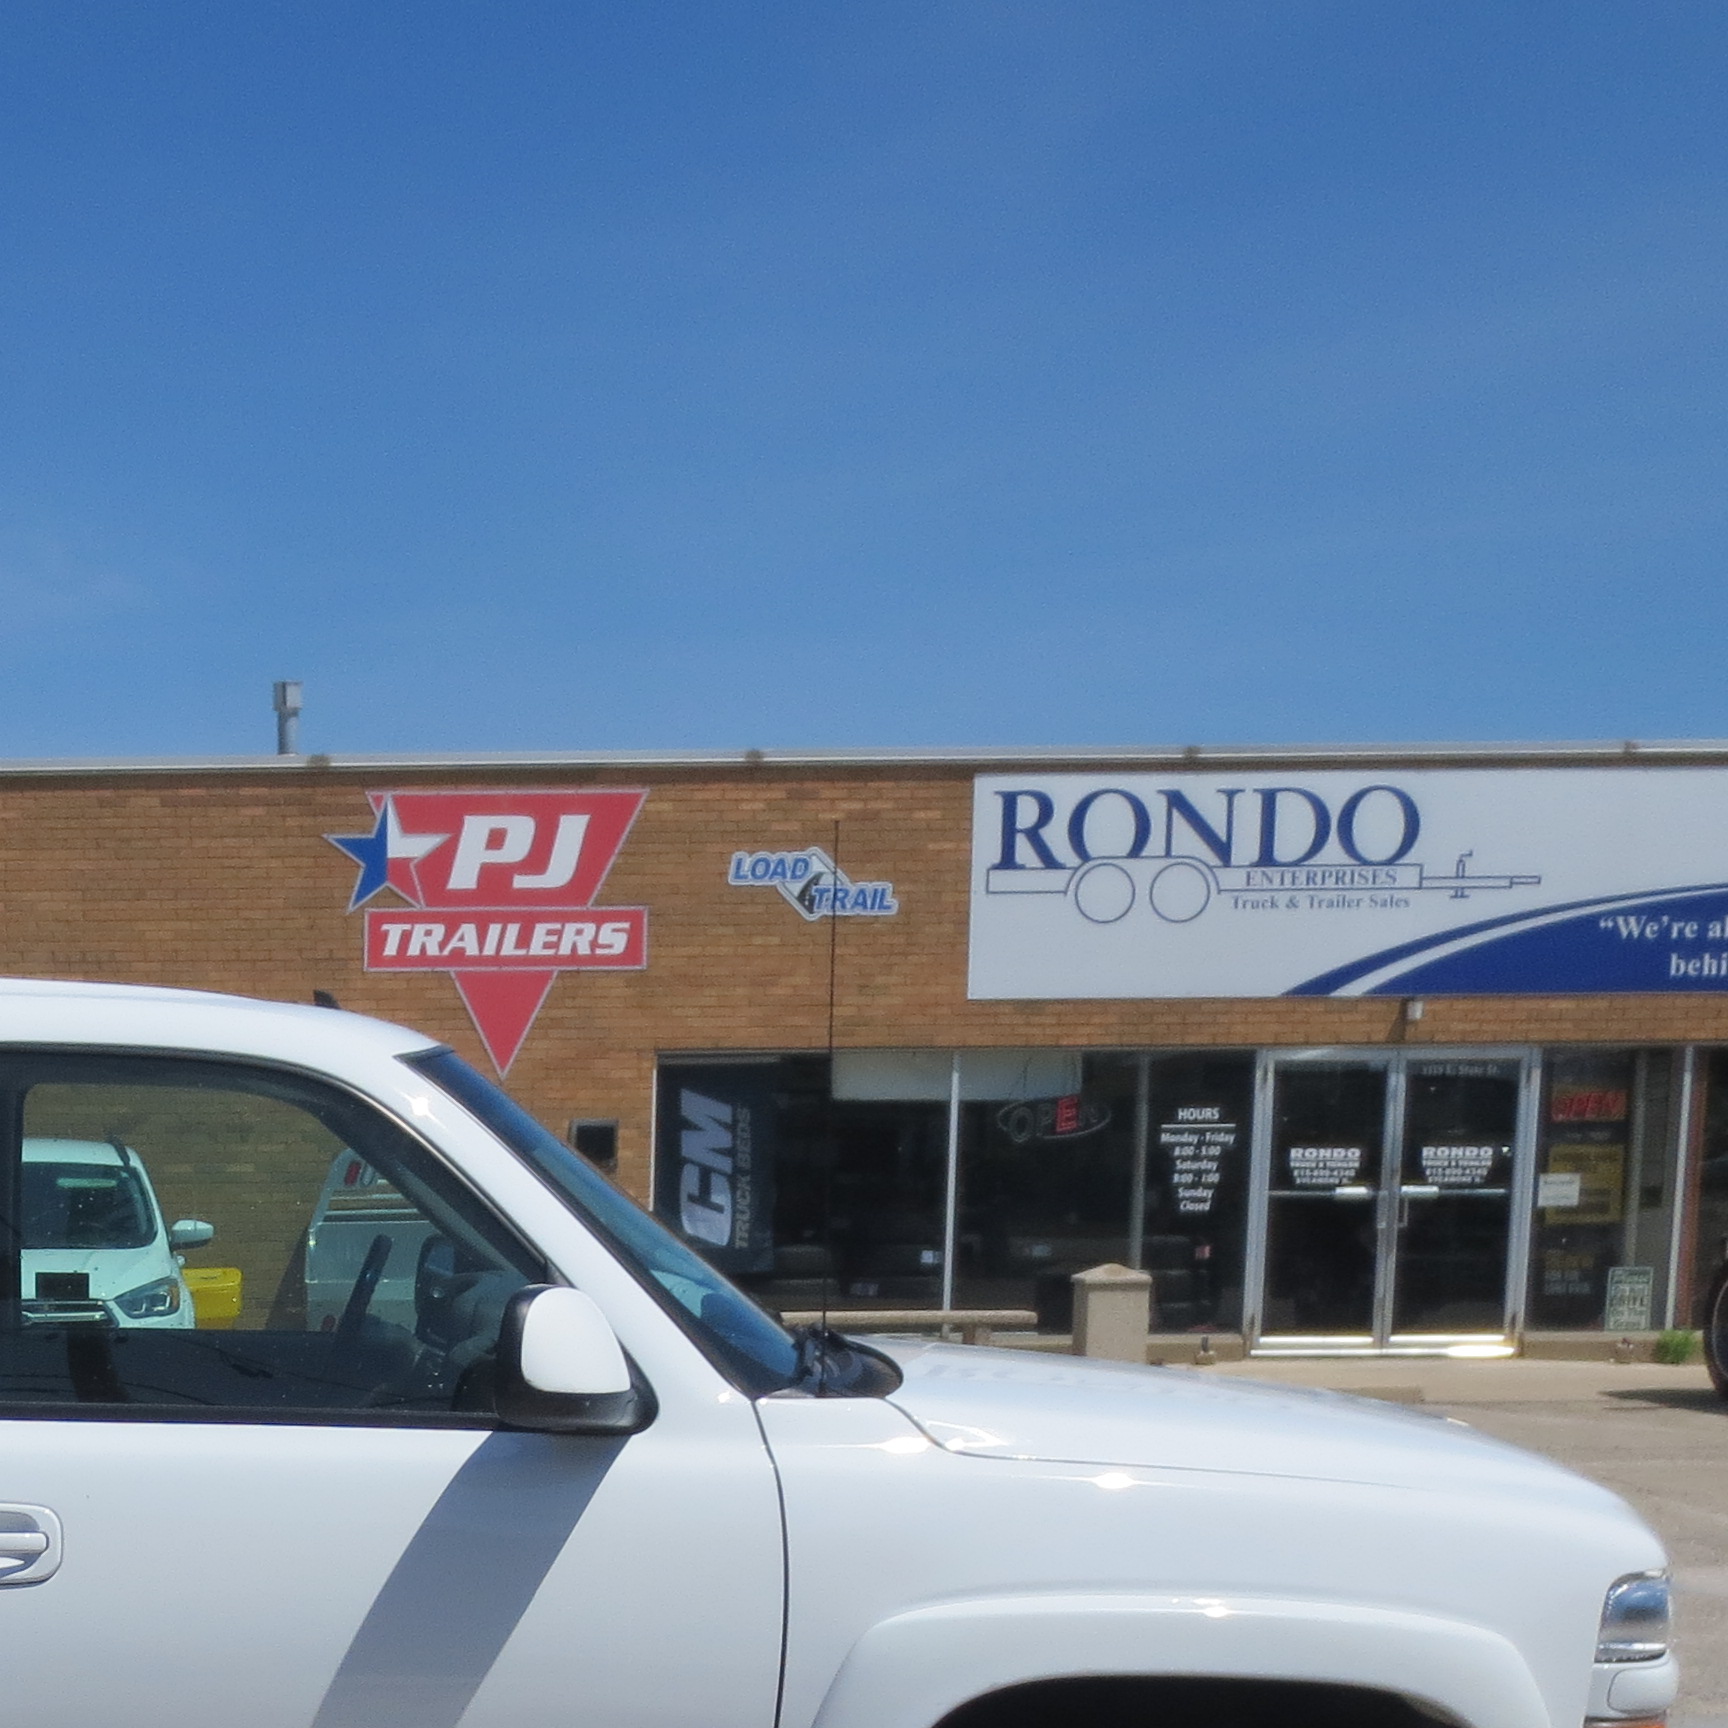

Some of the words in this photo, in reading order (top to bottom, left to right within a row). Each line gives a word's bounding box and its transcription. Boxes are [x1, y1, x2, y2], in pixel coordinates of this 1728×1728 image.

[993, 784, 1421, 869] RONDO
[446, 814, 591, 890] PJ
[733, 857, 810, 880] LOAD
[1245, 867, 1398, 887] ENTERPRISES
[812, 887, 892, 910] TRAIL
[1232, 893, 1279, 910] Truck
[1285, 893, 1299, 909] &
[1307, 893, 1362, 909] Trailer
[1368, 892, 1410, 909] Sales
[380, 921, 631, 957] TRAILERS
[1178, 1107, 1220, 1120] HOURS
[736, 1107, 752, 1169] BEDS
[1161, 1131, 1199, 1144] Monday
[1205, 1131, 1236, 1145] Friday
[1290, 1147, 1361, 1159] RONDO
[1422, 1146, 1493, 1158] RONDO
[680, 1088, 733, 1246] CM
[1175, 1159, 1219, 1171] Saturday
[1178, 1186, 1214, 1198] Sunday
[735, 1174, 752, 1248] TRUCK
[1180, 1200, 1212, 1211] Closed
